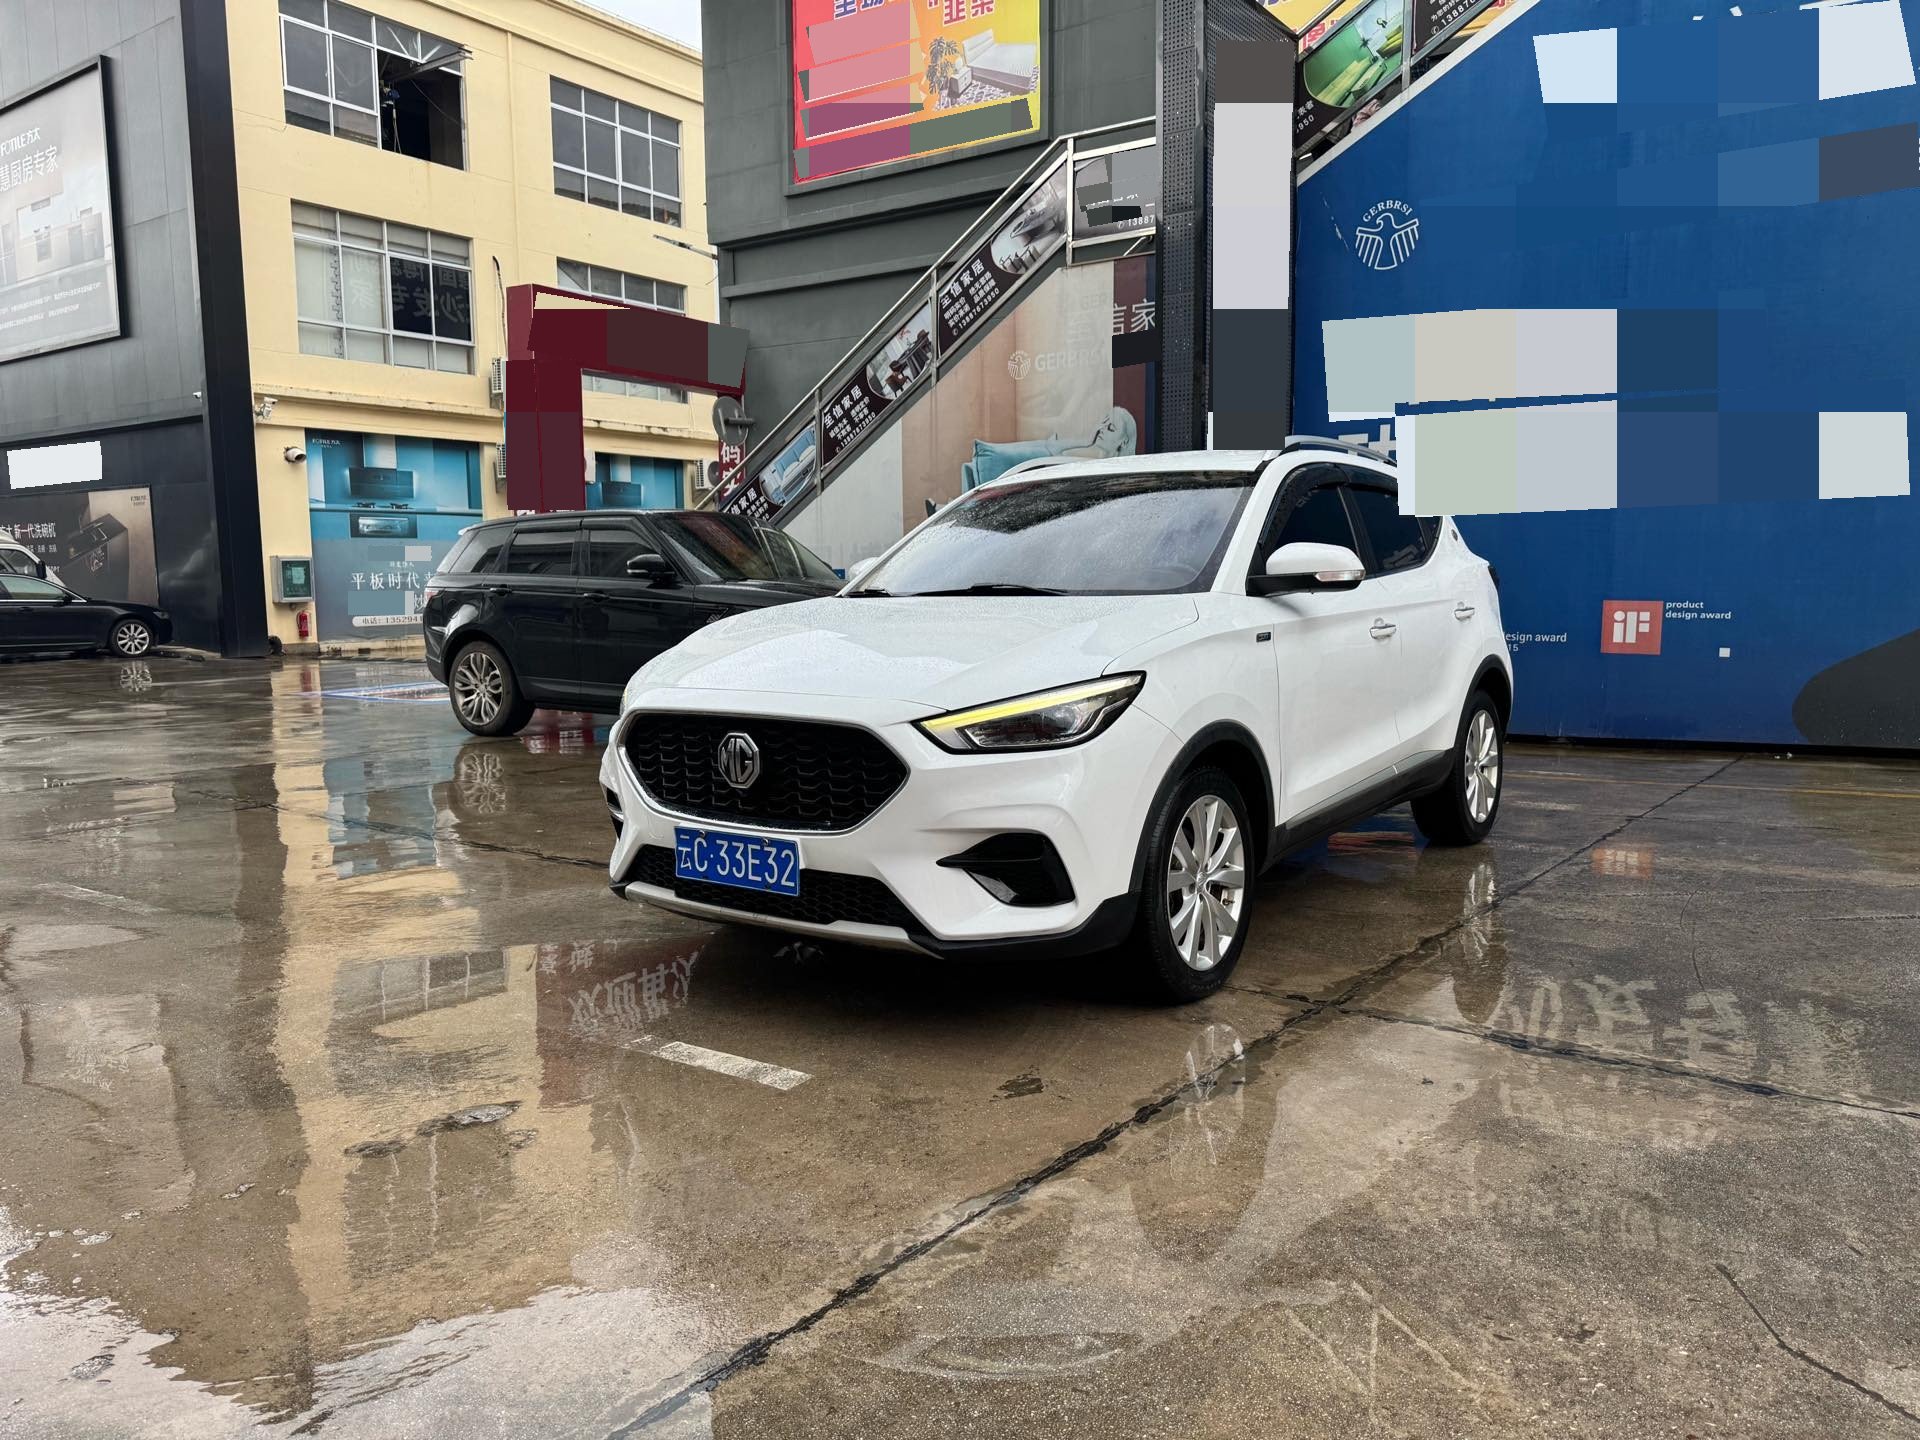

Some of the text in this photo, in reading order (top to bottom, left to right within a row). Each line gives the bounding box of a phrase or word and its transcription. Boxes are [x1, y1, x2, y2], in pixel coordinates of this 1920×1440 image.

[1363, 200, 1413, 222] GERBRSI
[941, 259, 984, 309] 至信家居
[959, 288, 999, 328] 13887673950
[824, 385, 862, 428] 至信家居
[1665, 611, 1731, 620] design award
[1666, 600, 1704, 610] product
[1504, 632, 1567, 644] esign award
[720, 738, 753, 783] MG
